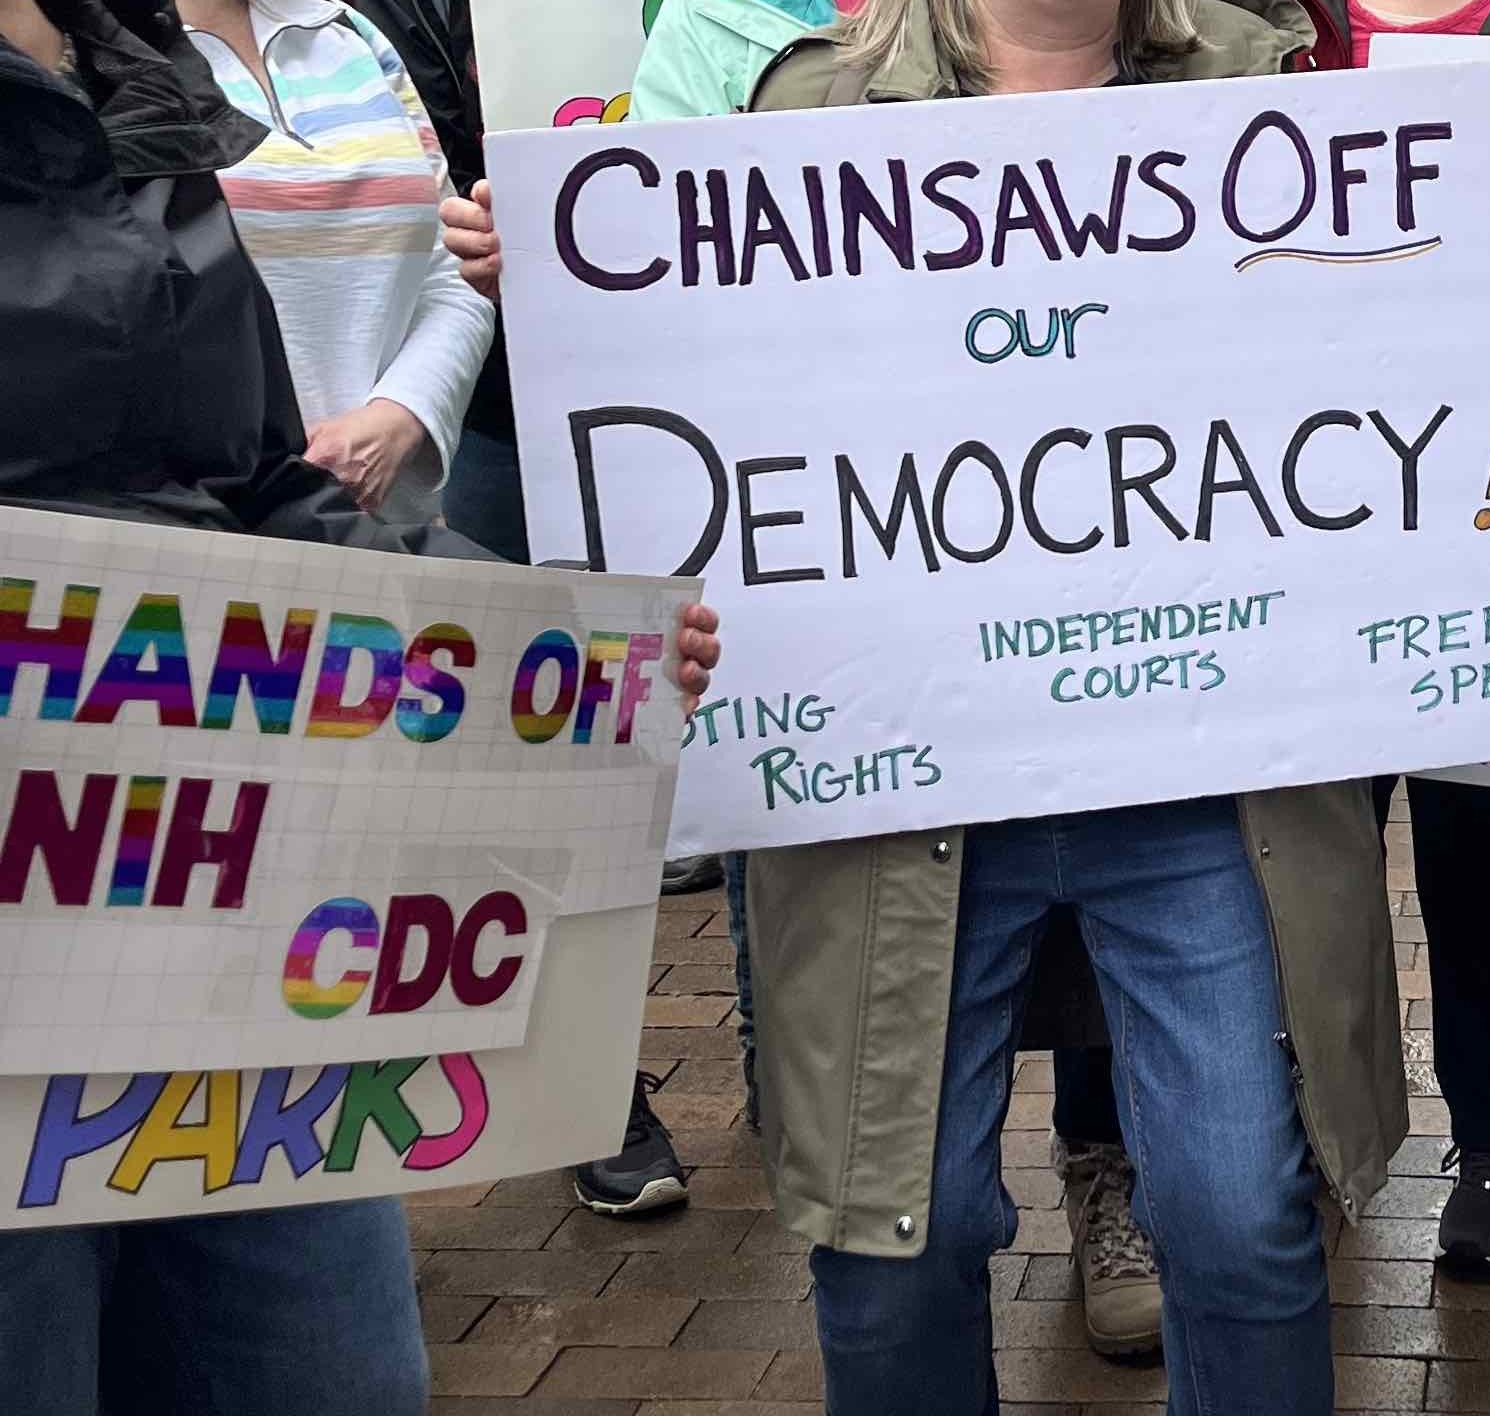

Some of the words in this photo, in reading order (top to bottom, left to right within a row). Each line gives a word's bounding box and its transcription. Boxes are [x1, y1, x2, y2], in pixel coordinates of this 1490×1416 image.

[555, 146, 1196, 291] CHAINSAWS
[1222, 110, 1452, 243] OFF
[0, 576, 477, 743] HANDS
[510, 628, 663, 744] OFF
[980, 591, 1285, 662] INDEPENDENT
[1050, 649, 1226, 703] COURTS
[681, 693, 835, 750] TING
[0, 769, 270, 909] NIH
[281, 890, 527, 1020] CDC
[17, 1052, 488, 1208] PARKS
